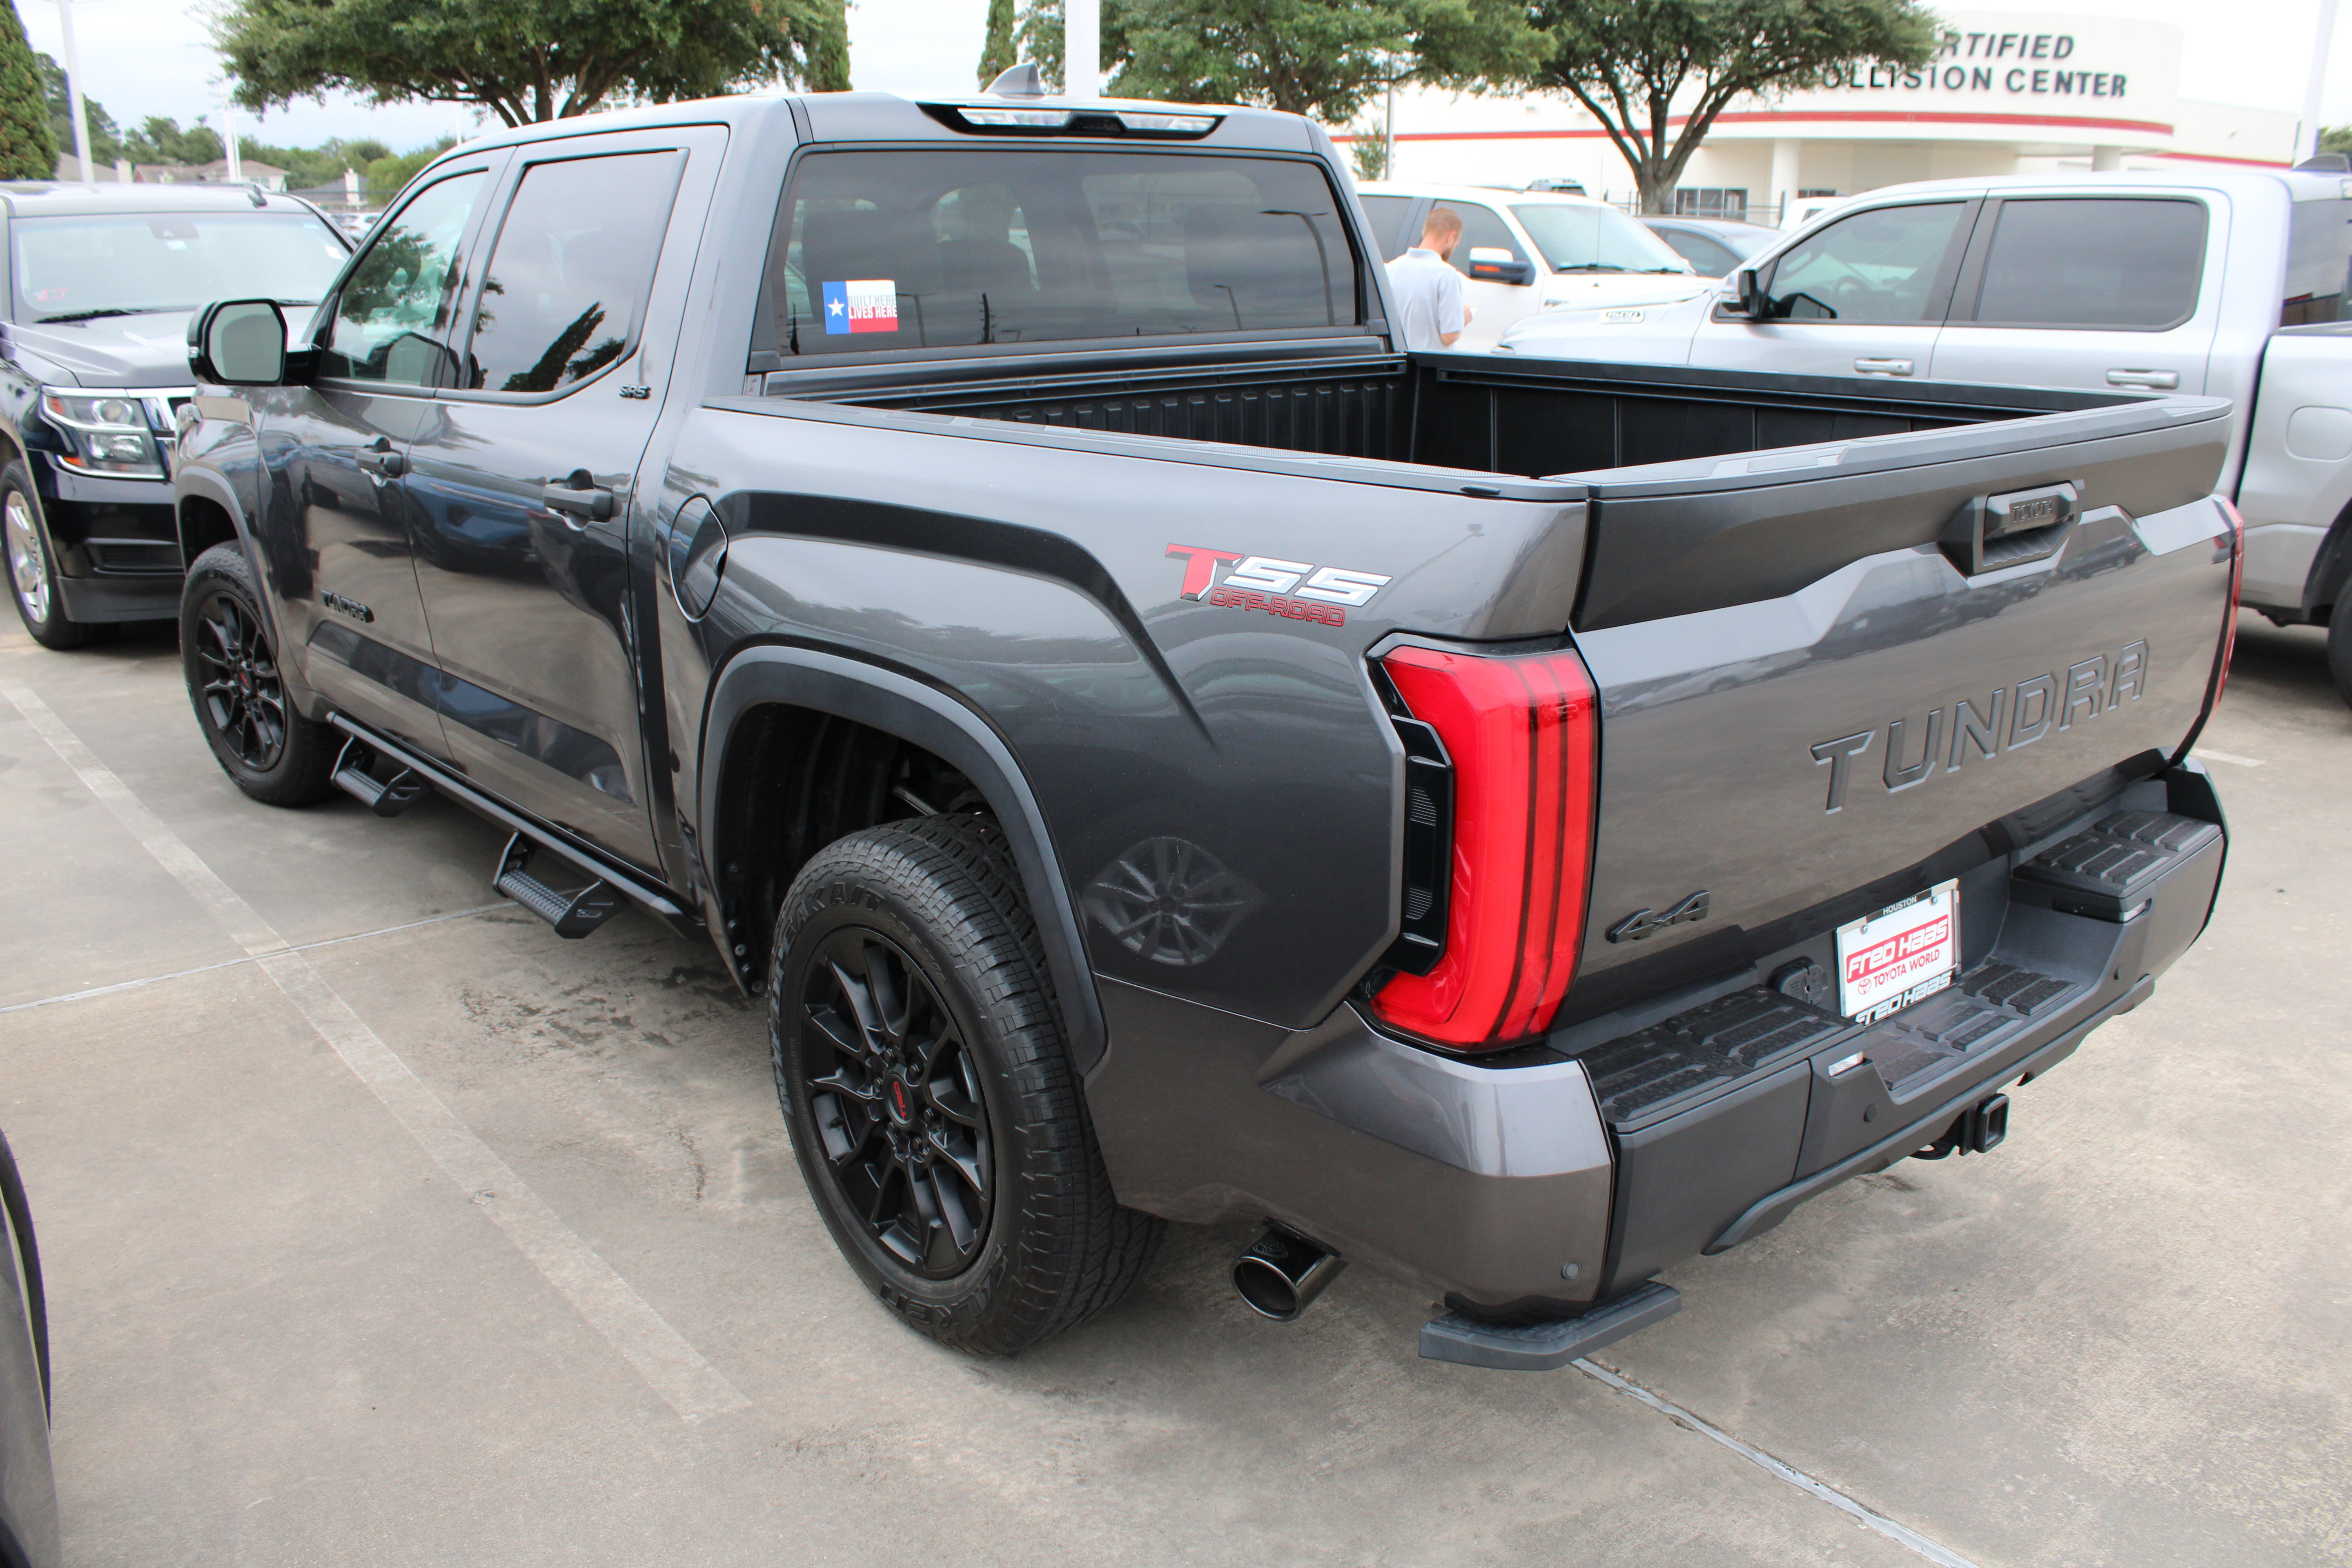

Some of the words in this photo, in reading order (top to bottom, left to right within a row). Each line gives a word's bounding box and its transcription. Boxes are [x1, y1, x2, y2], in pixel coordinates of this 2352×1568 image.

[1940, 30, 2075, 58] RTIFIED
[1824, 65, 1993, 90] OLLISION
[2006, 68, 2127, 97] CENTER
[848, 296, 872, 307] BUILT
[875, 294, 896, 306] HERE
[848, 307, 873, 319] LIVES
[875, 306, 898, 318] HERE
[619, 385, 652, 400] SR5
[2012, 499, 2053, 523] TOYOTA
[1165, 543, 1394, 608] TSS
[1209, 587, 1346, 627] OFF-ROAD
[1809, 638, 2149, 815] TUNDRA
[1883, 896, 1917, 916] HOUSTON
[1873, 965, 1907, 987] TOYOTA
[1909, 949, 1940, 970] WORLD
